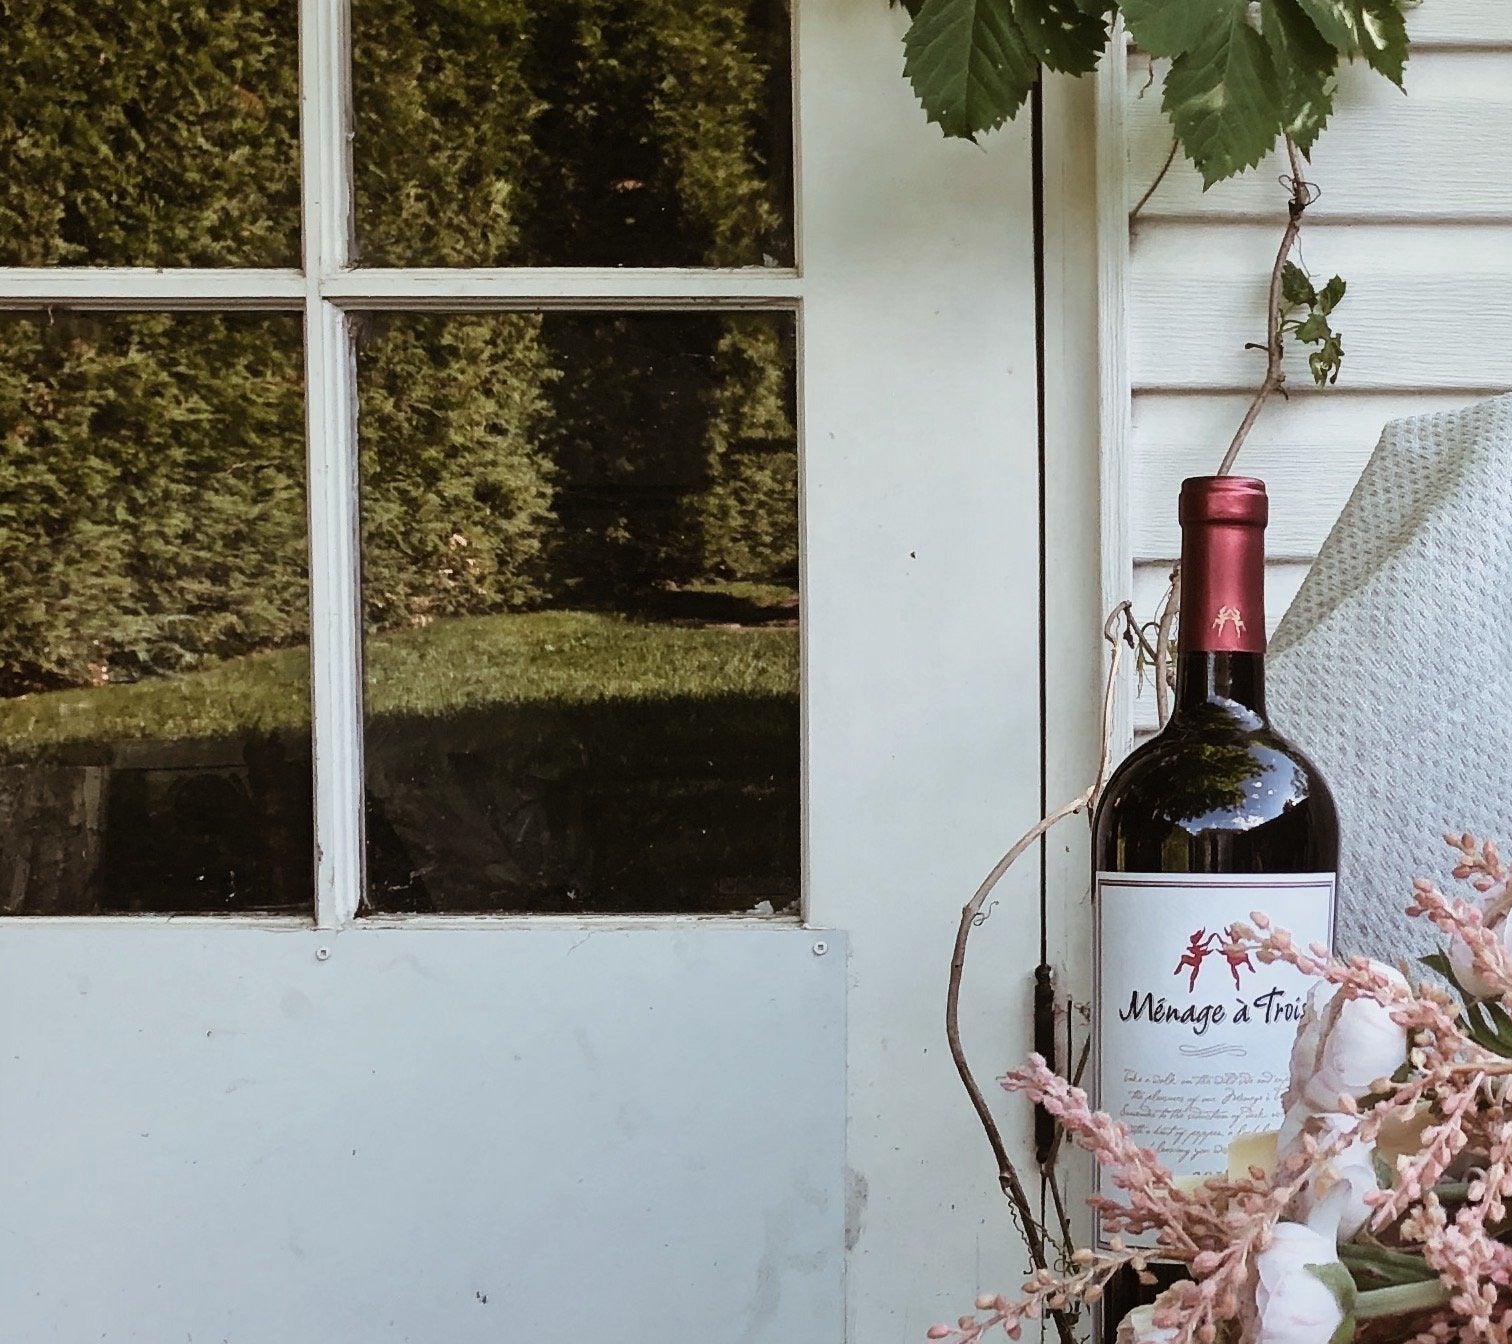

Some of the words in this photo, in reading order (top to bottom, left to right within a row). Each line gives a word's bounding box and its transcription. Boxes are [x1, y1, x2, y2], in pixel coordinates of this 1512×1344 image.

[1119, 990, 1225, 1035] Ménage
[1233, 998, 1250, 1023] à
[1253, 986, 1307, 1024] Trois
